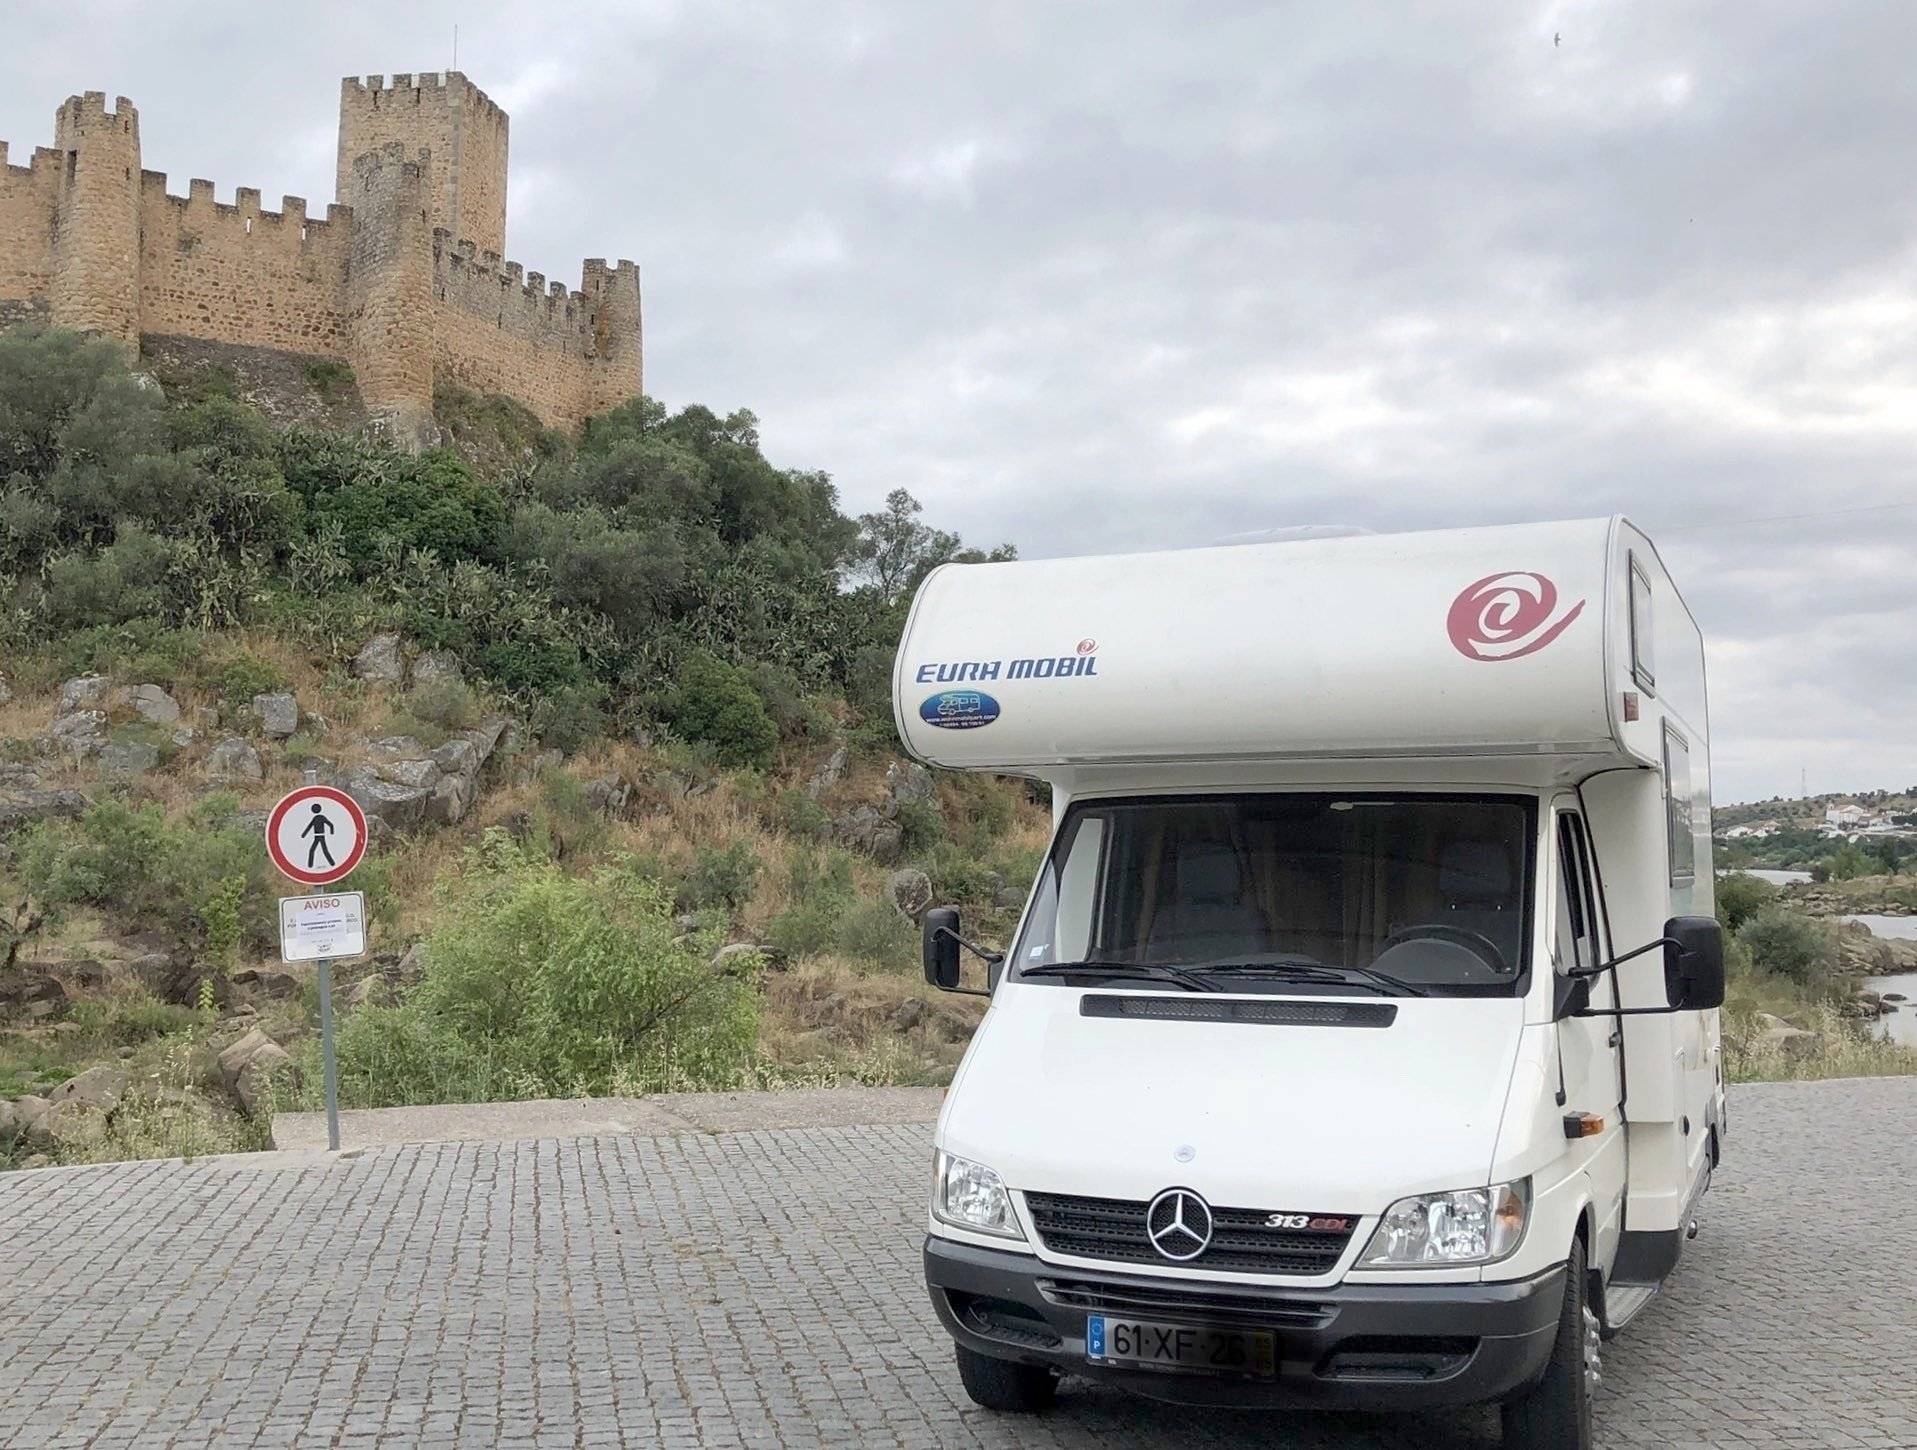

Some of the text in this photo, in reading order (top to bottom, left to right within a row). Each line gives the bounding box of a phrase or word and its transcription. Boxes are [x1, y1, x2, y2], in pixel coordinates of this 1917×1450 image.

[916, 656, 1097, 683] EURA MOBIL
[304, 898, 340, 911] AVISO
[1093, 1340, 1101, 1350] P
